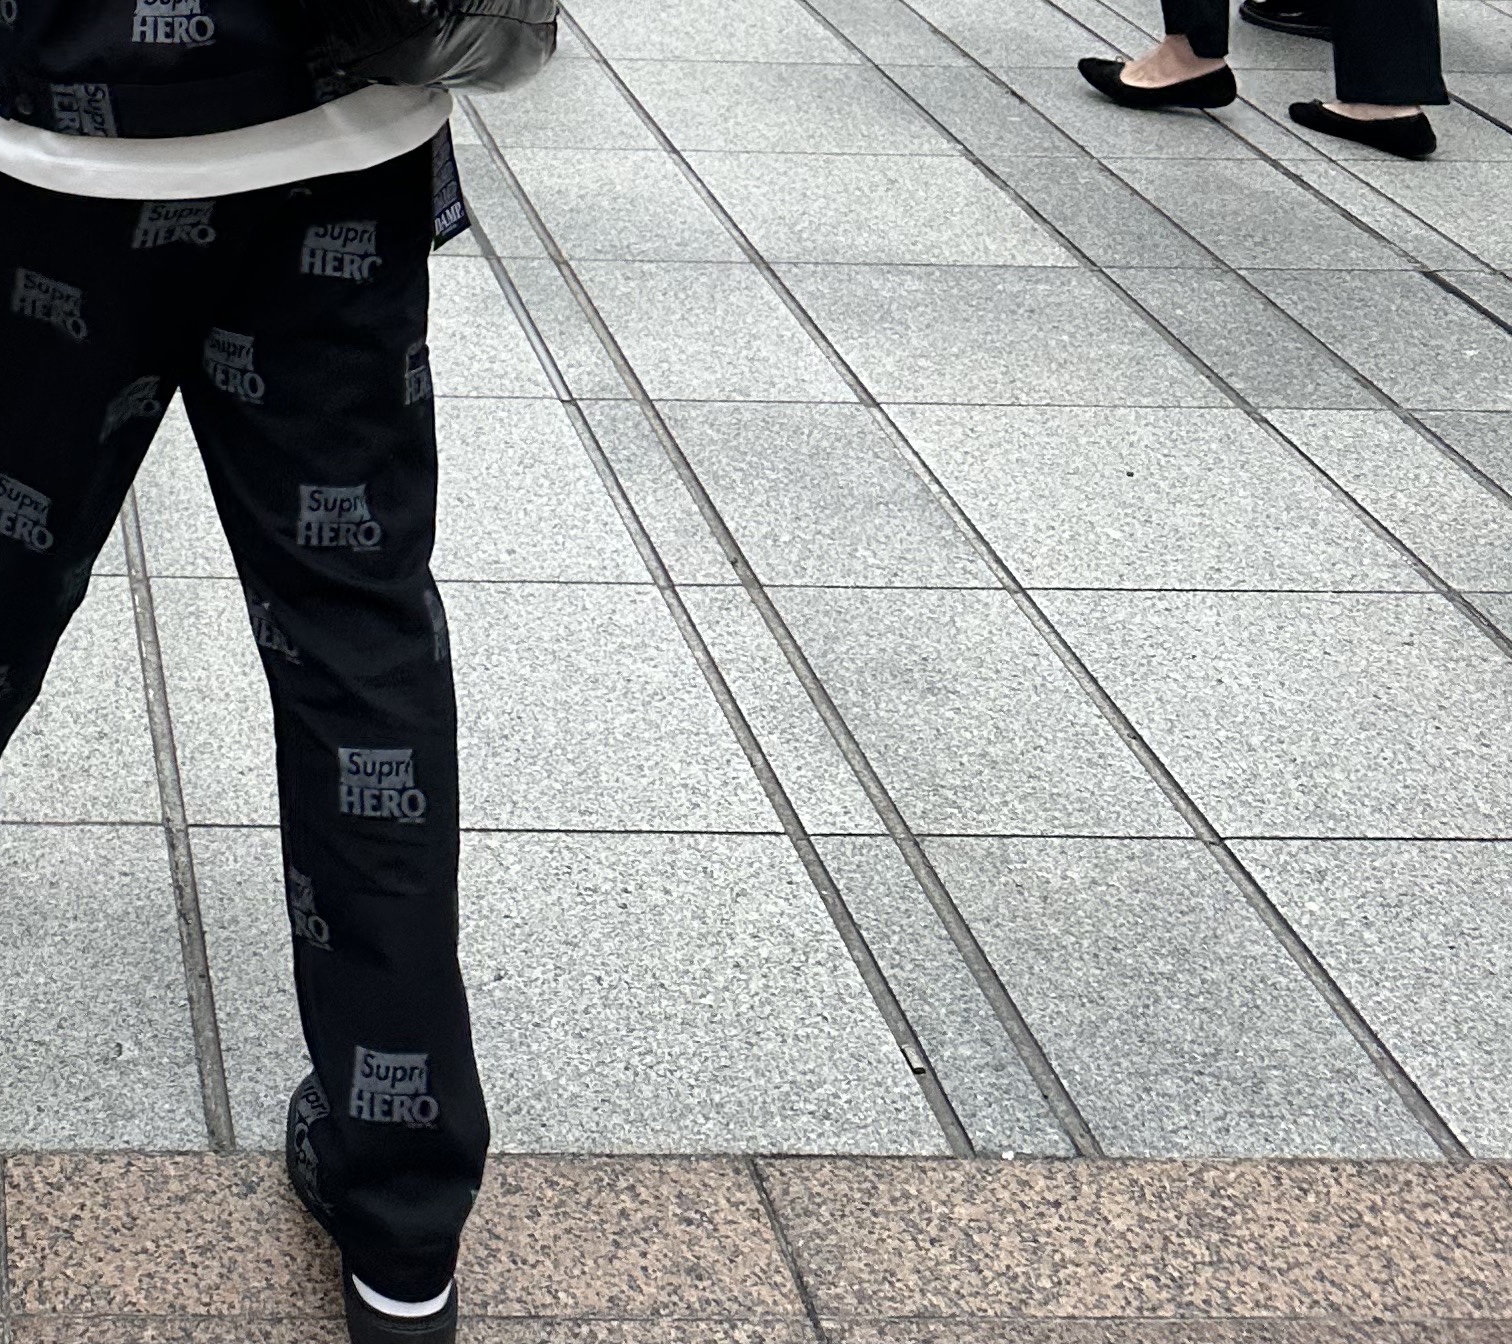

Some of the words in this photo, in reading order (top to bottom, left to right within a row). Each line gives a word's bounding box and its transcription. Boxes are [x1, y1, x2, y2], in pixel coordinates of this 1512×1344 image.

[132, 14, 215, 45] HERO
[131, 224, 216, 249] HERO
[296, 520, 382, 547] HERO
[339, 785, 428, 818] HERO
[349, 1090, 440, 1124] HERO
